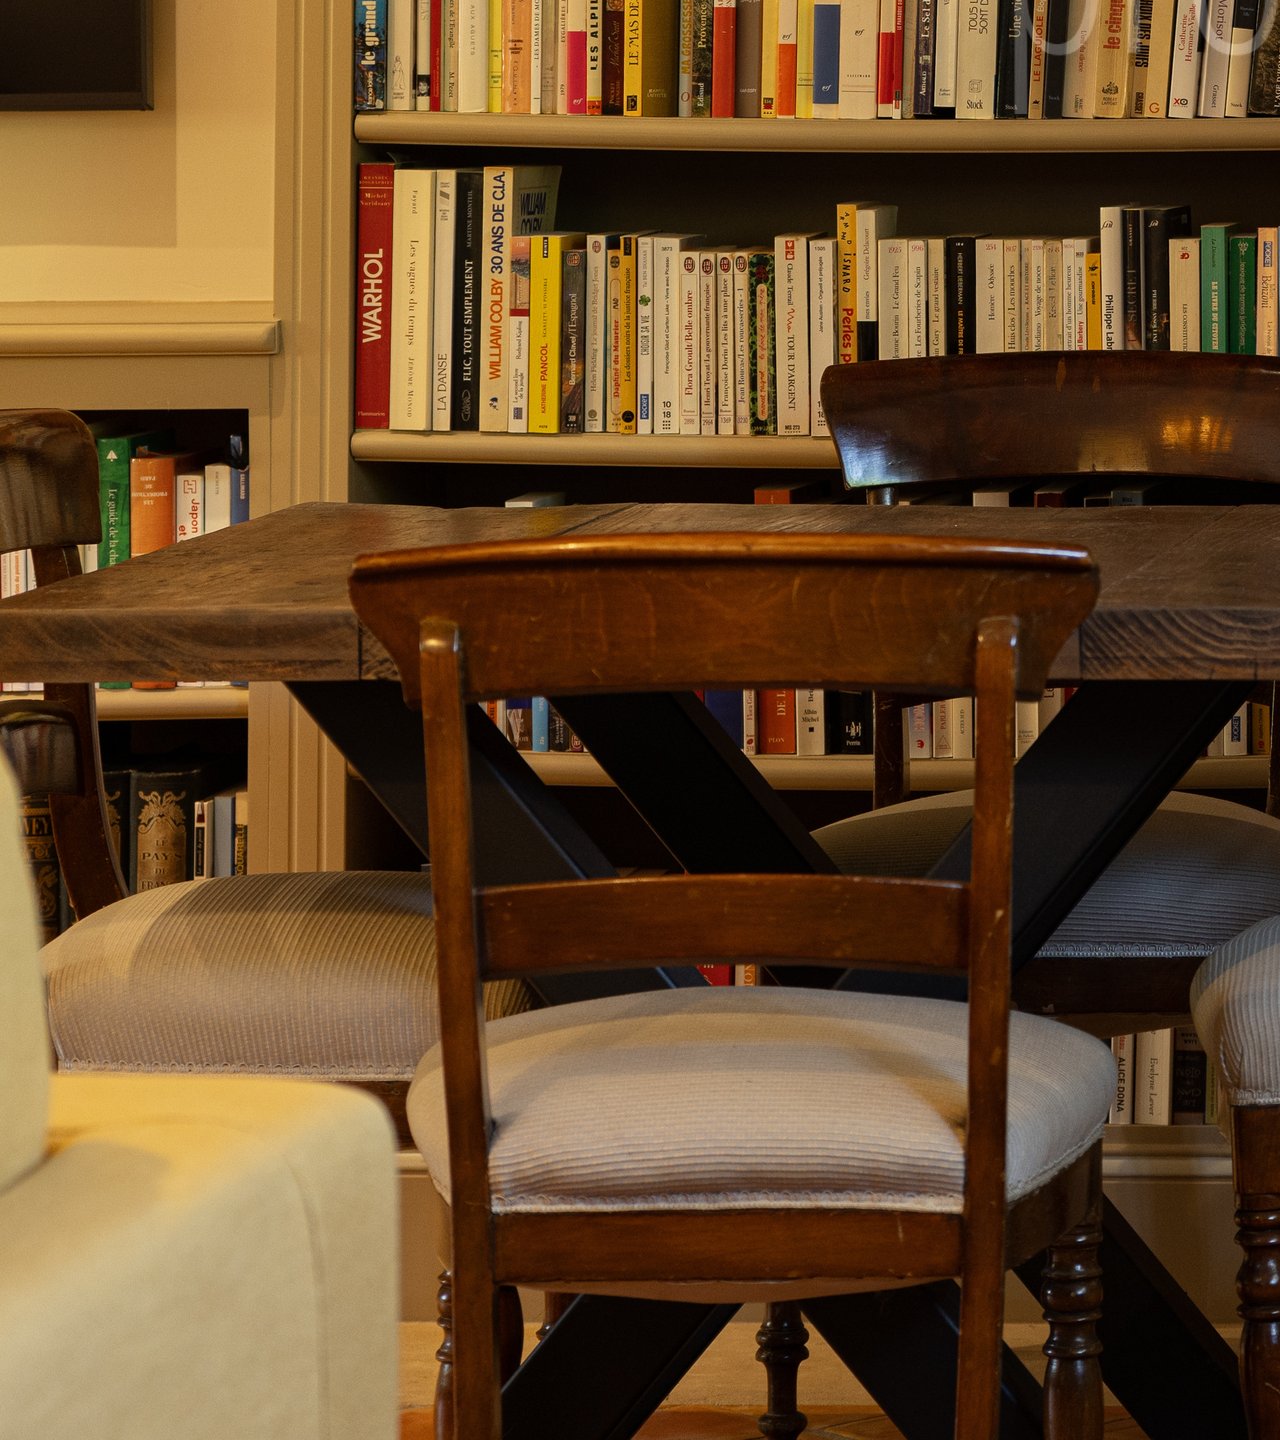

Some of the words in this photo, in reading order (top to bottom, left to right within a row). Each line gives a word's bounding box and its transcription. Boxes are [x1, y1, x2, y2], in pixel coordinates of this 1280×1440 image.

[361, 0, 379, 46] grand
[698, 4, 708, 48] Provence
[968, 6, 978, 32] TOUS
[979, 7, 989, 34] SONT
[1009, 13, 1021, 38] Une
[628, 20, 640, 46] MAS
[1103, 37, 1121, 50] le
[361, 51, 377, 65] le
[590, 46, 599, 70] LES
[628, 50, 639, 65] LE
[492, 171, 506, 201] C.I.A.
[492, 204, 505, 222] DE
[491, 226, 504, 253] ANS
[490, 256, 504, 274] 30
[362, 249, 384, 343] WARHOL
[463, 259, 474, 324] SIMPLEMENT
[489, 279, 503, 323] COLBY
[463, 327, 473, 354] TOUT
[489, 325, 502, 380] WILLIAM
[437, 353, 447, 392] DANSE
[463, 357, 474, 381] FLIC,
[540, 343, 548, 381] PANCOL
[438, 396, 447, 411] LA
[191, 499, 200, 533] Japon
